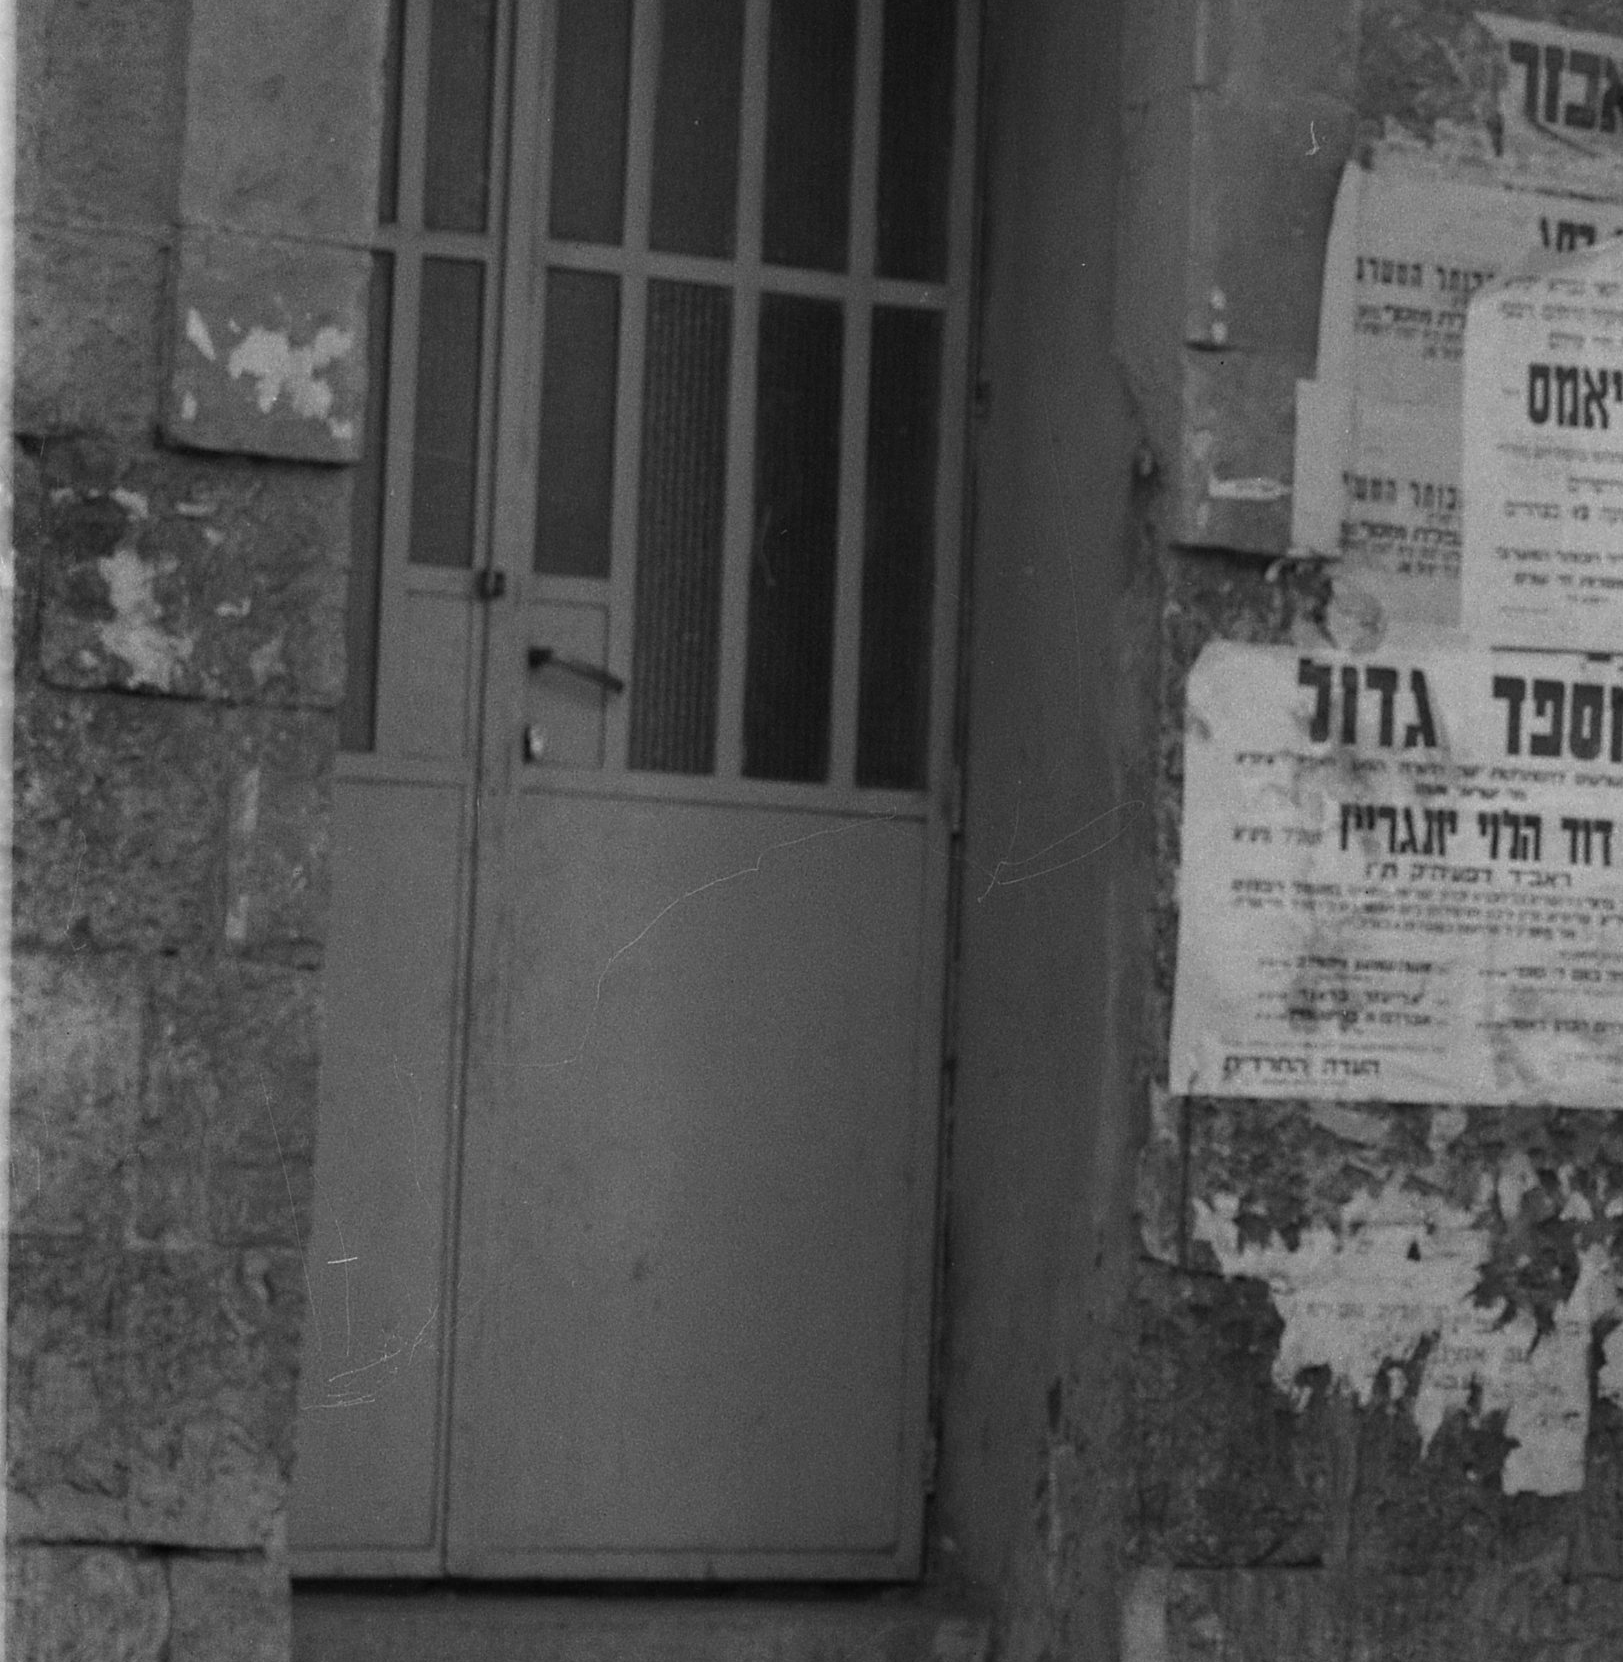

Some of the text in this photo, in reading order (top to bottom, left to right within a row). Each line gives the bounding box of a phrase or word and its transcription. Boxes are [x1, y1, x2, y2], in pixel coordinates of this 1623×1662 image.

[1298, 657, 1438, 749] גדול
[1476, 808, 1543, 861] הלוי
[1560, 815, 1615, 868] דוד
